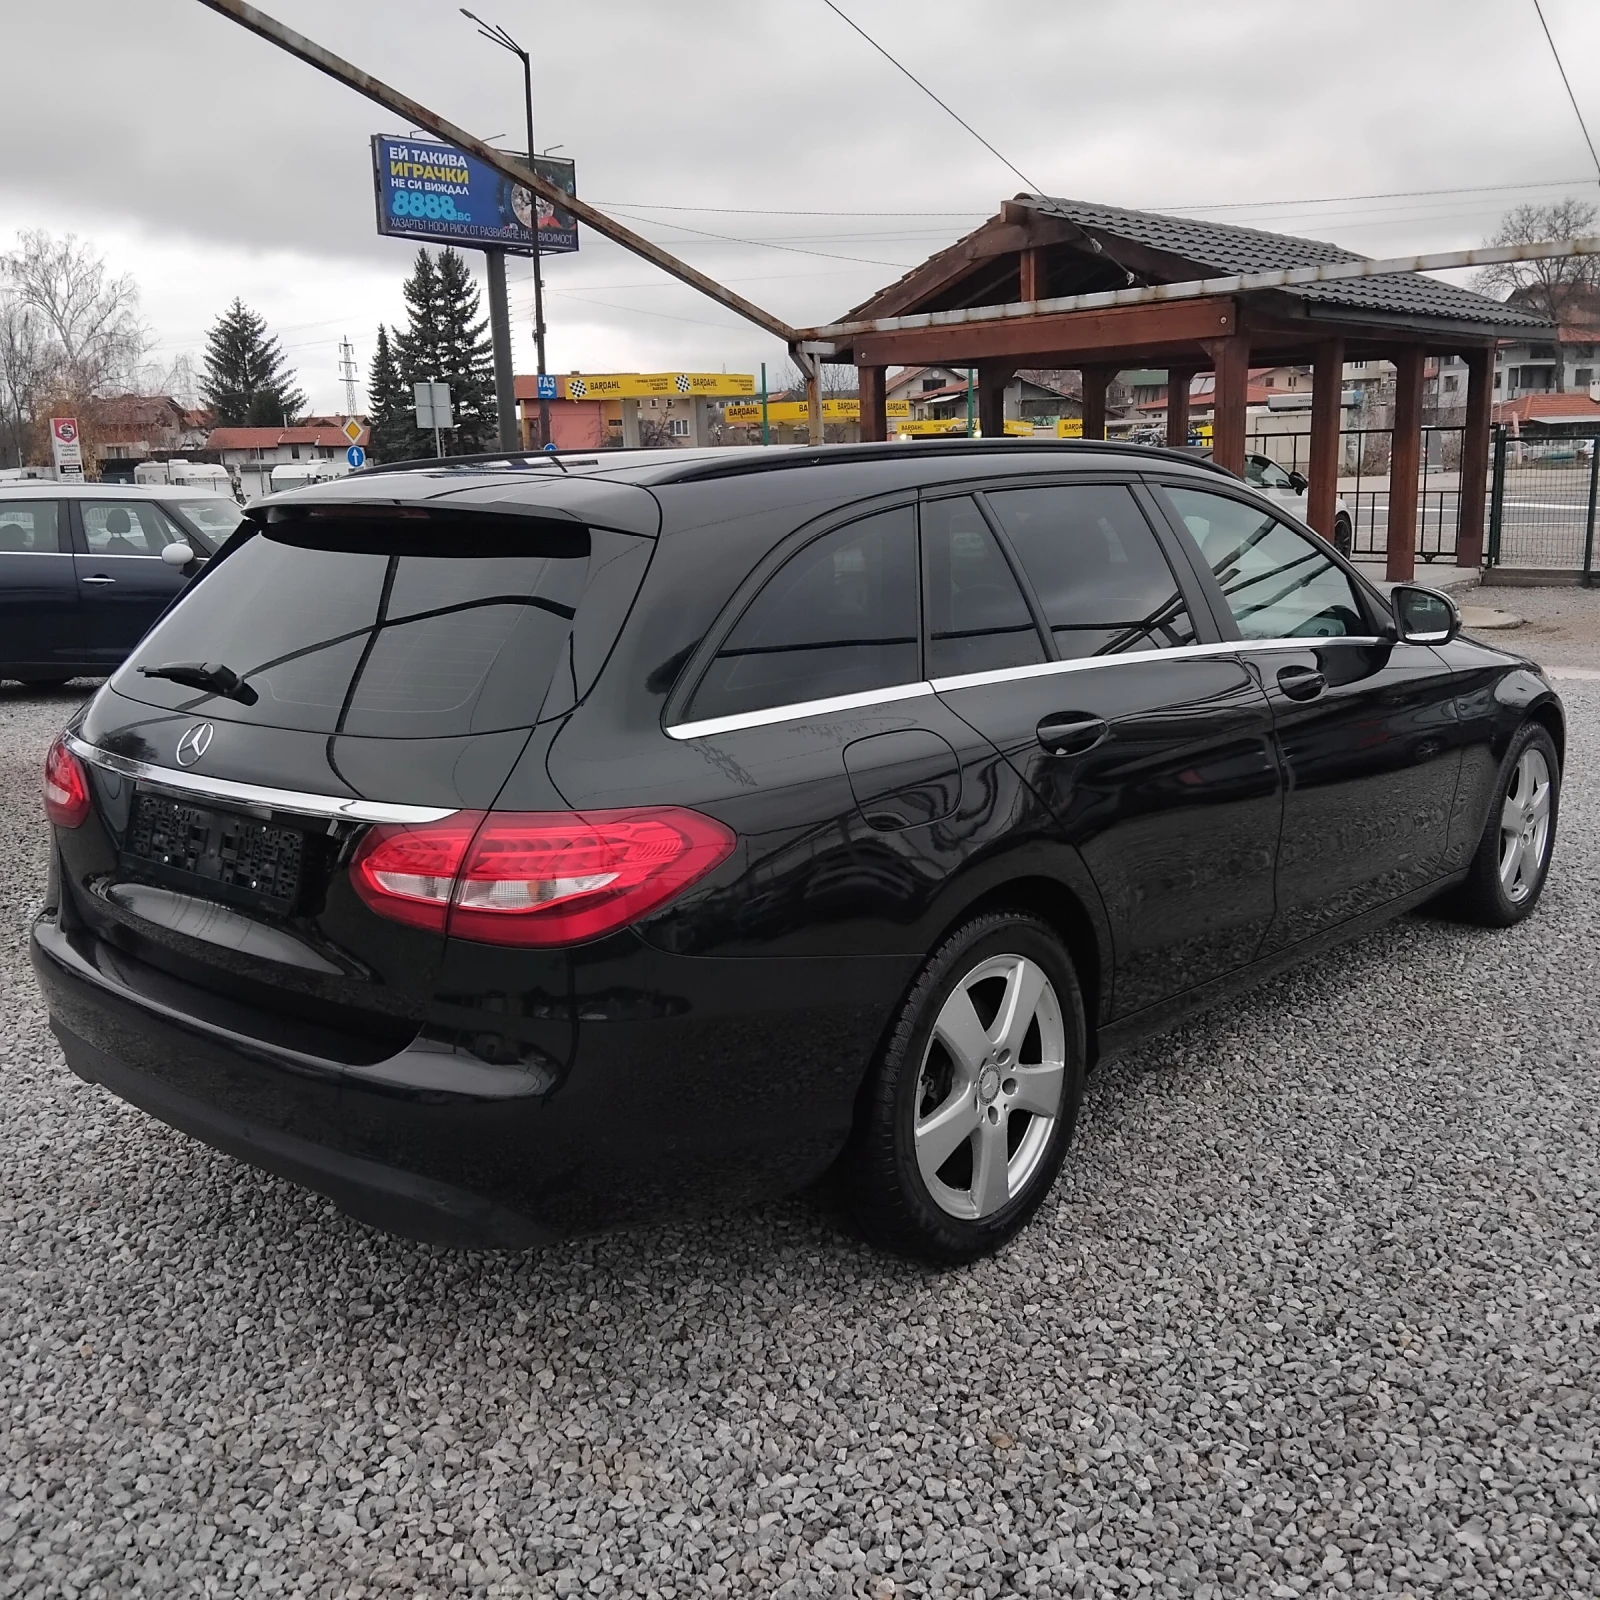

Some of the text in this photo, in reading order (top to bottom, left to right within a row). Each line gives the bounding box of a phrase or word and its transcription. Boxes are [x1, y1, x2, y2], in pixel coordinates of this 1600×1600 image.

[389, 146, 467, 168] ЕЙ ТАКИВА
[390, 161, 469, 184] ИГРАЧКИ
[391, 177, 469, 195] НЕ СИ ВИЖДАЛ
[391, 217, 573, 244] ХАЗАРТЪТ НОСИ РИСК ОТ РАЗВИВАНЕ НА ВИСИМОСТ
[538, 376, 555, 388] ГАЗ
[590, 380, 621, 393] BARDAHL
[692, 377, 718, 390] BARDAHL
[728, 406, 760, 419] BARDAHL
[798, 402, 831, 413] BAHL
[837, 402, 860, 414] BARDAHL
[887, 402, 908, 414] BARDAHL
[901, 424, 925, 433] BARDAHL
